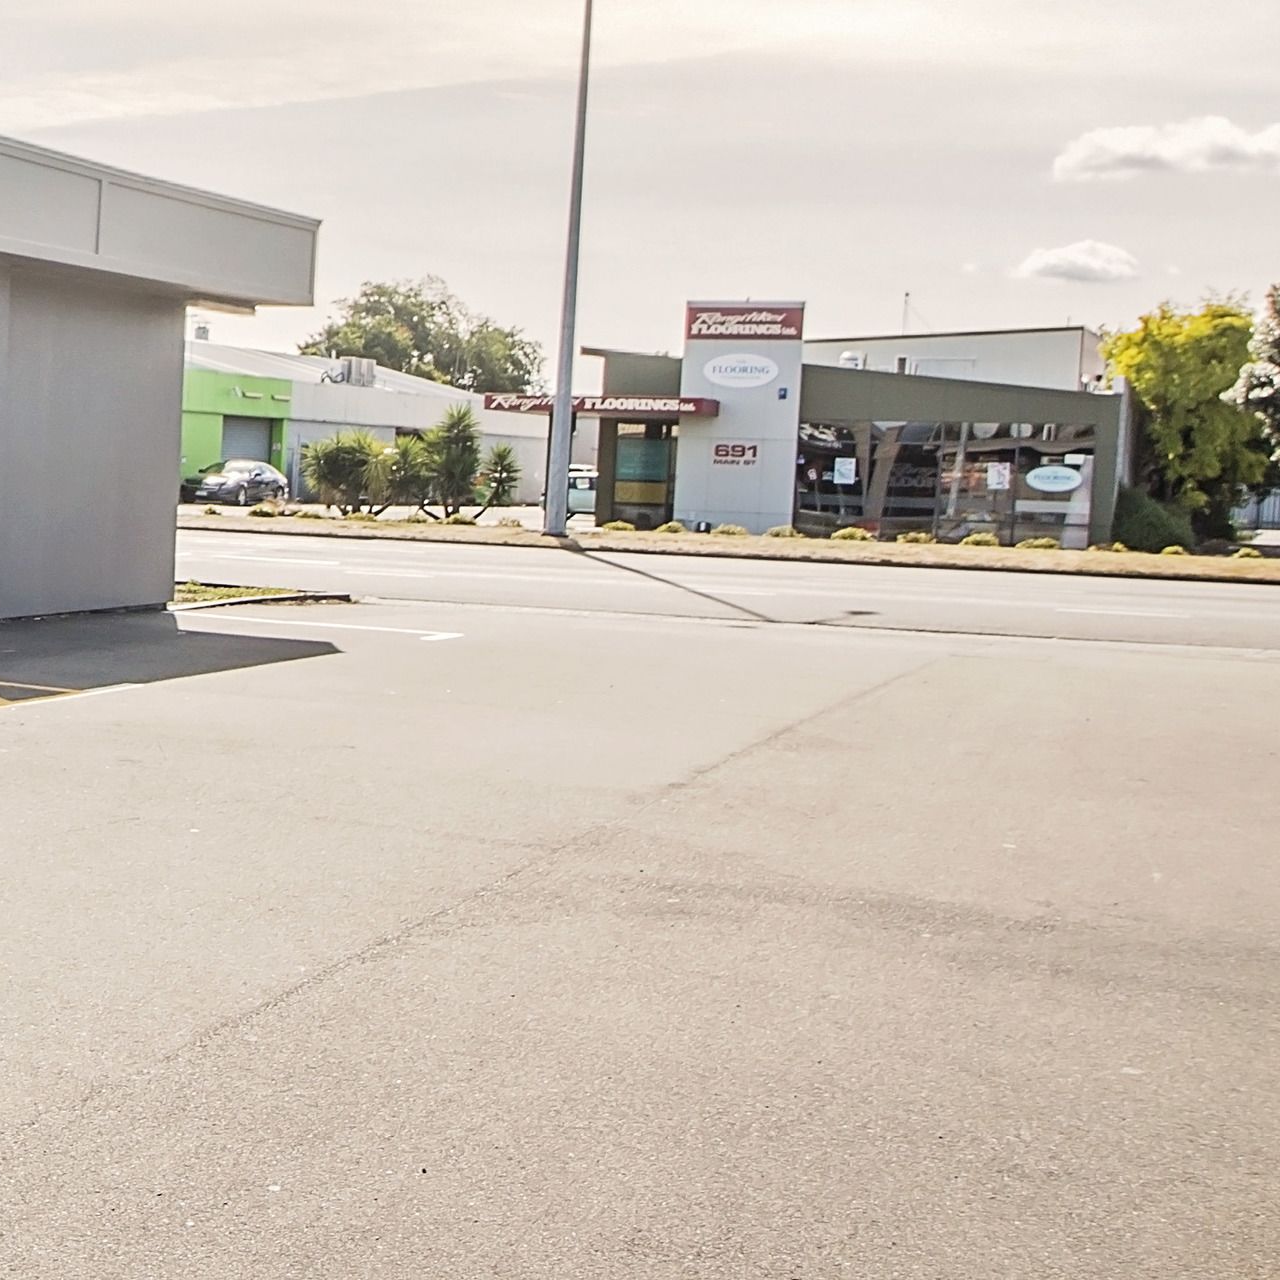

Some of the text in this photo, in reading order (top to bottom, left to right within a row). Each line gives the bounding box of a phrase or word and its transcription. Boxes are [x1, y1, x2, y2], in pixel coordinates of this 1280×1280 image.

[690, 323, 782, 335] FLOORINGS
[712, 365, 771, 375] FLOORING
[583, 397, 680, 412] FLOORINGS
[714, 443, 758, 458] 691
